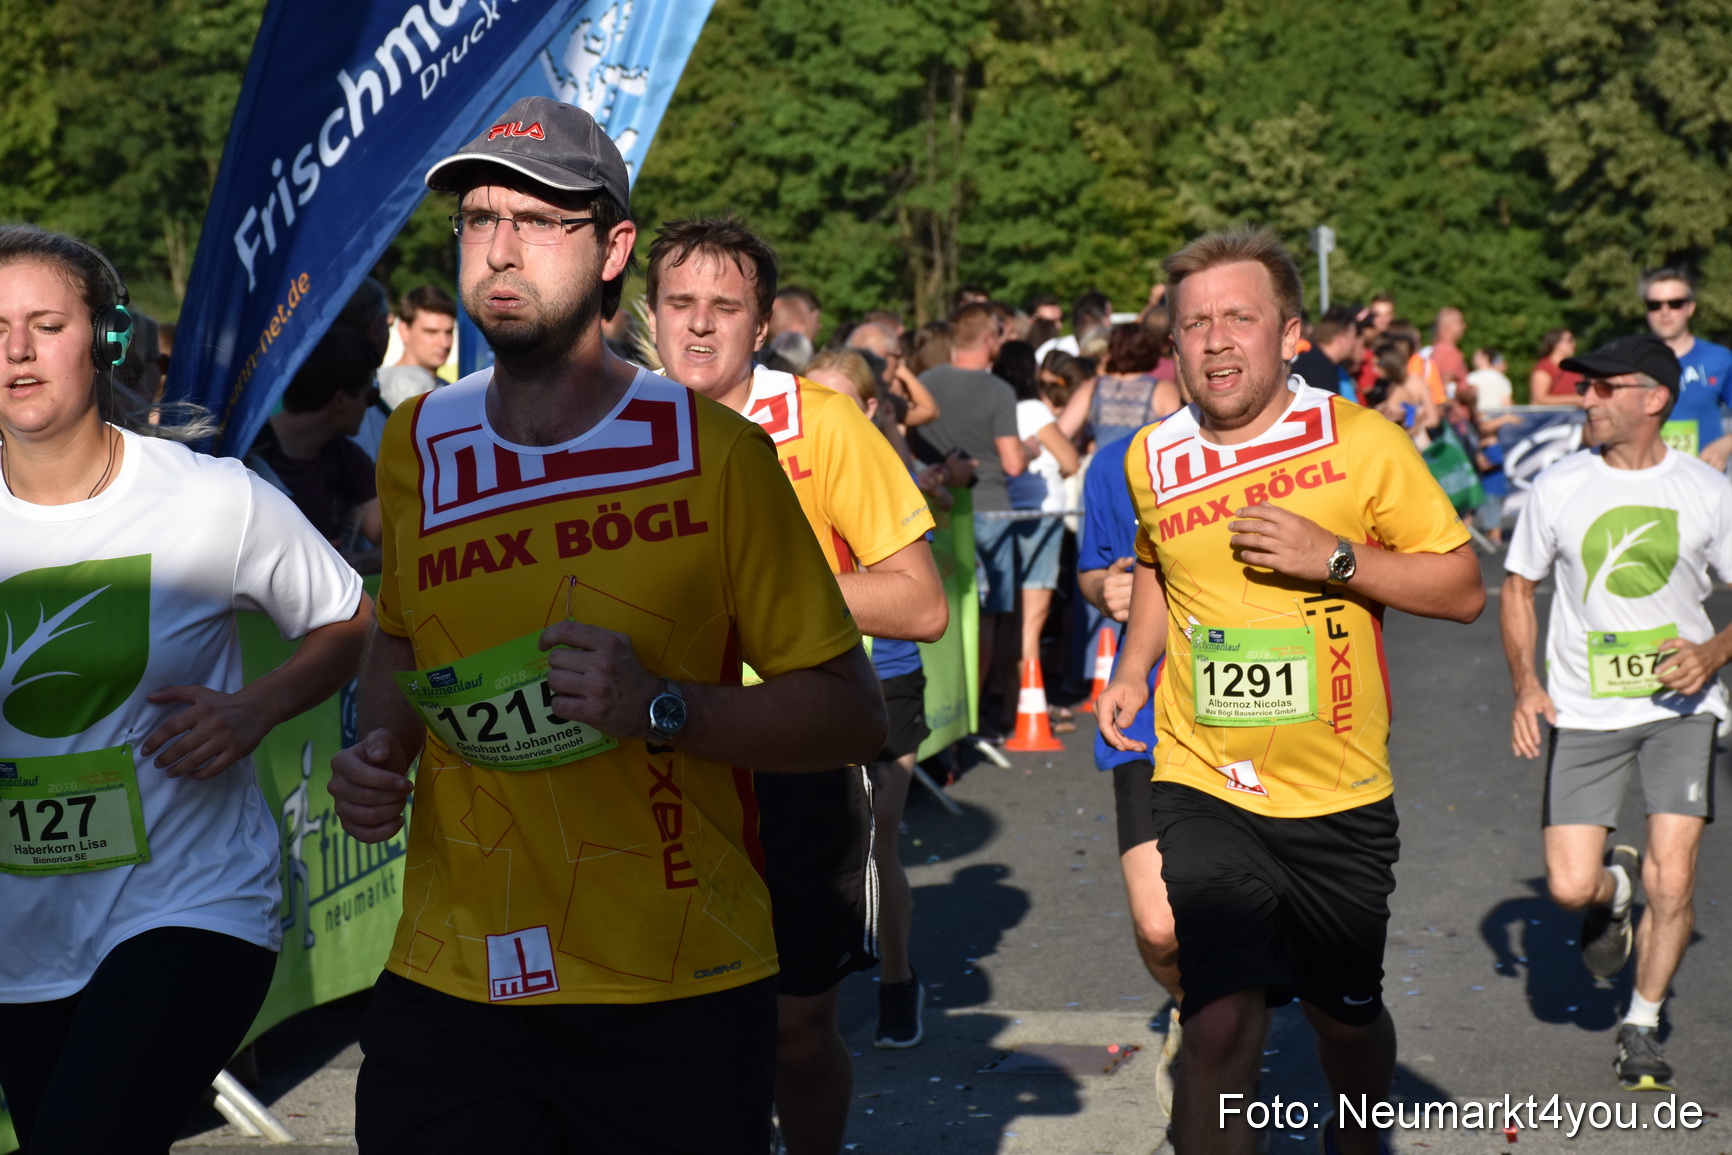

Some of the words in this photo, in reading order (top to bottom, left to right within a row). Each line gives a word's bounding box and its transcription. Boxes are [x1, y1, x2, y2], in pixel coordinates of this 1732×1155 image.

[419, 0, 500, 100] Druck
[488, 121, 545, 141] FILA
[1158, 494, 1235, 543] MAX
[1244, 460, 1347, 507] BÖGL
[418, 528, 538, 592] MAX
[555, 499, 709, 559] BÖGL
[1246, 650, 1270, 660] 2018
[1609, 653, 1660, 678] 167
[422, 673, 483, 696] firmenlauf
[495, 671, 527, 690] 2018
[1203, 661, 1293, 698] 1291
[1205, 708, 1216, 716] Max
[1218, 708, 1233, 718] Bögl
[1234, 707, 1273, 716] Bauservice
[1274, 707, 1297, 716] GmbH
[1208, 698, 1251, 709] Albornoz
[1253, 699, 1292, 709] Nicolas
[456, 740, 509, 755] Gebhard
[514, 725, 582, 752] Johannes
[462, 750, 478, 760] Max
[480, 751, 500, 763] Bögl
[501, 747, 552, 762] Bauservice
[554, 737, 584, 752] GmbH
[48, 782, 78, 793] 2018
[9, 795, 97, 842] 127
[14, 844, 76, 855] Haberkorn
[80, 839, 107, 851] Lisa
[33, 856, 73, 865] Bionorica
[75, 853, 87, 861] SE
[325, 867, 397, 932] neumarkt
